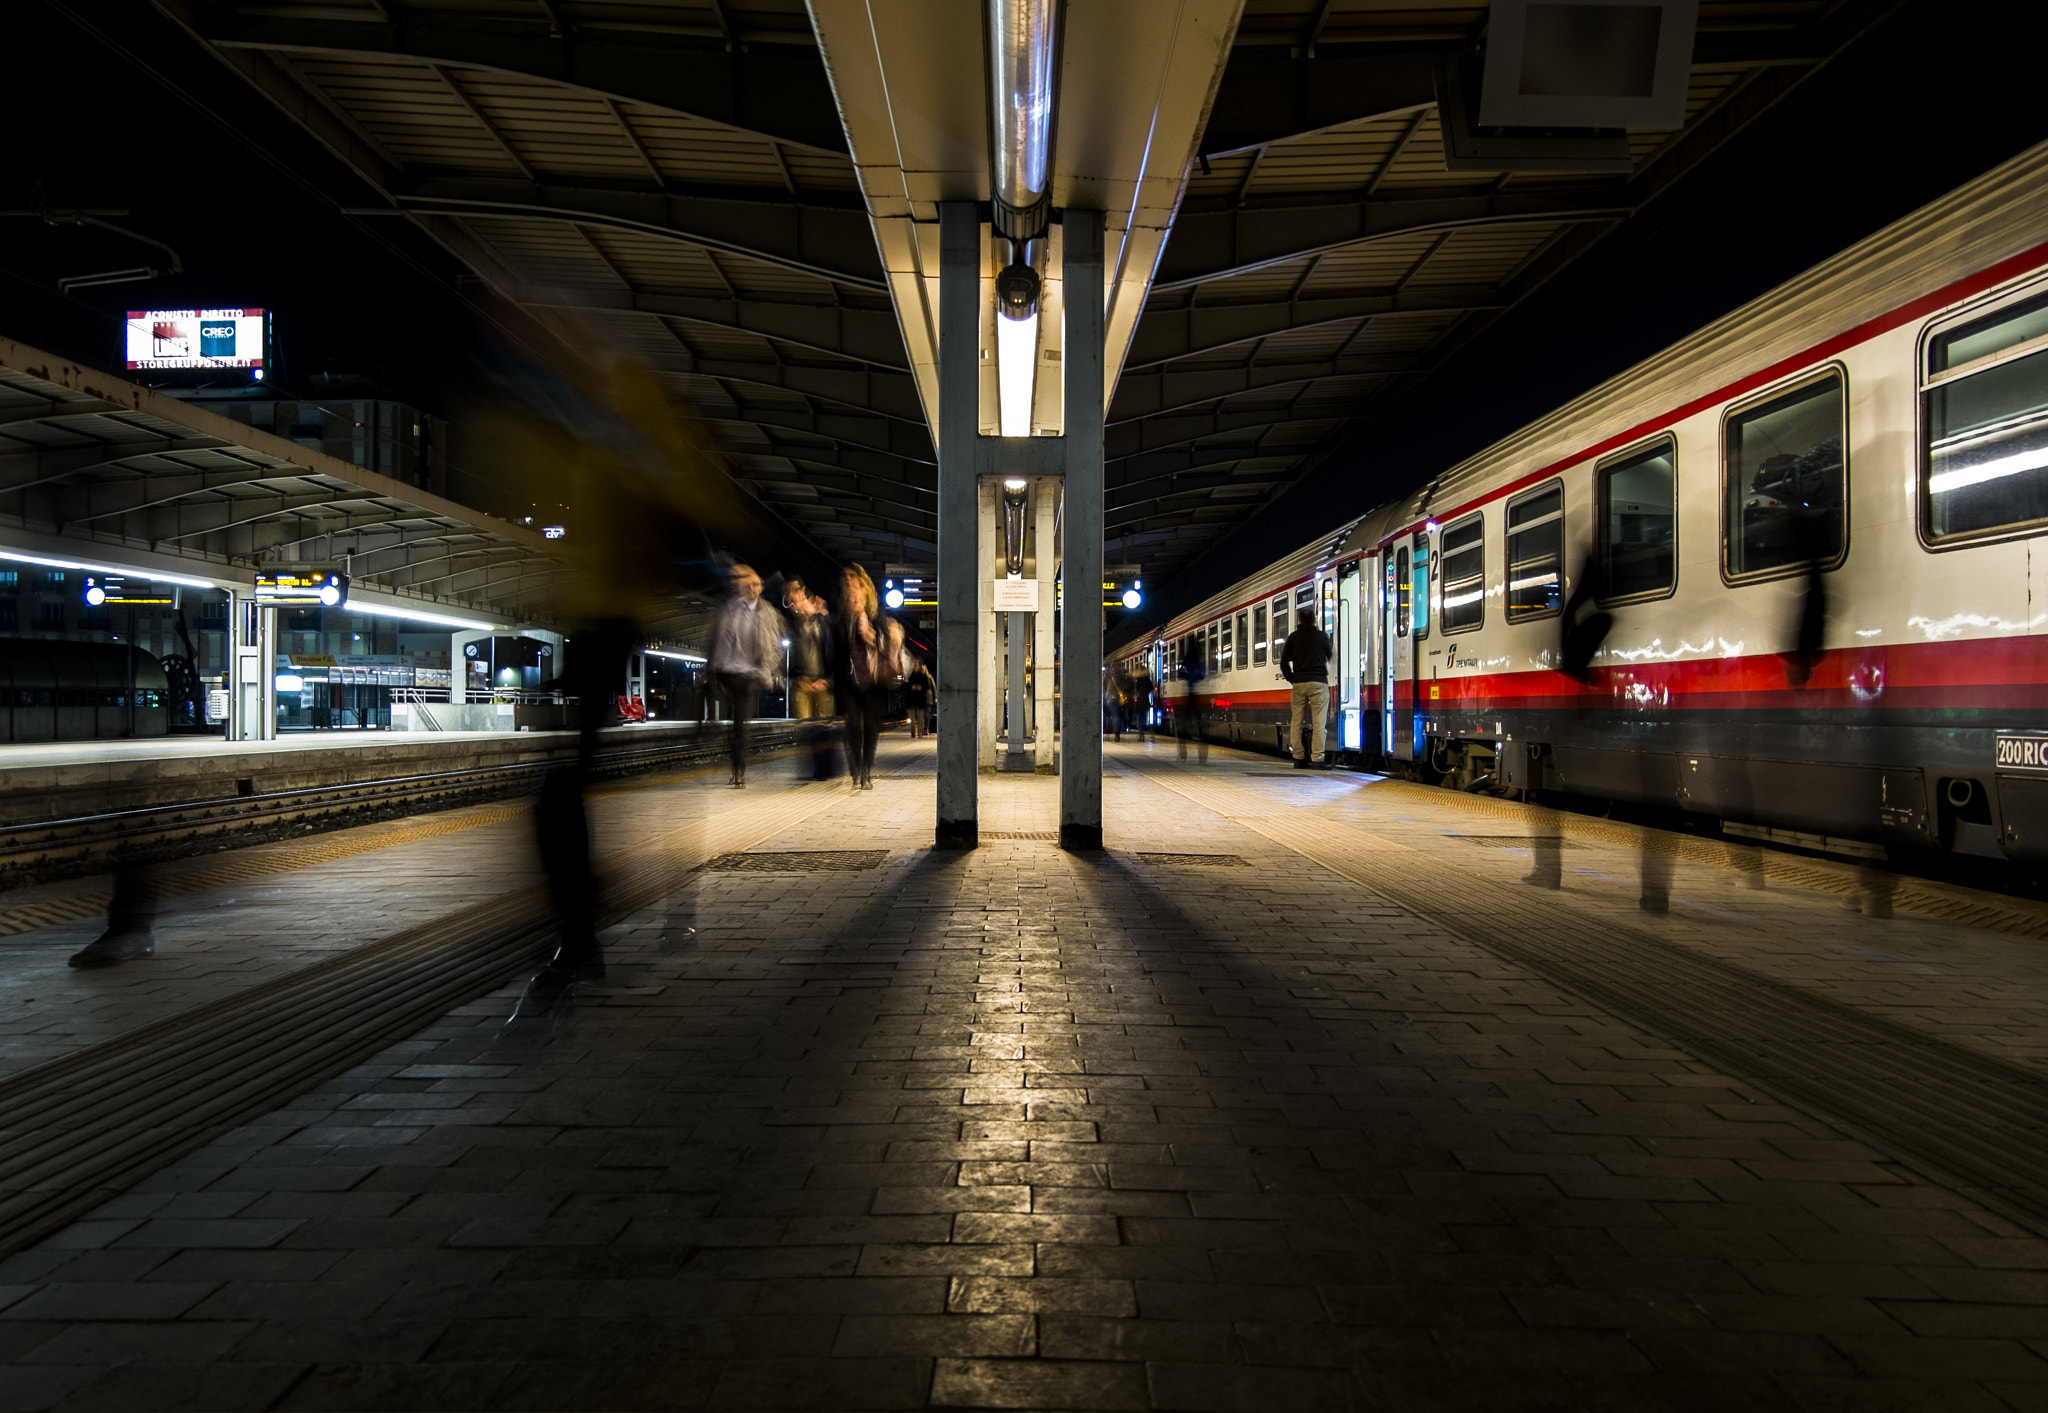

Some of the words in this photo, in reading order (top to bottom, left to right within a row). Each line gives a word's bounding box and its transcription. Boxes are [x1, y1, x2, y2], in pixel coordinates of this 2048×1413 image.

[201, 309, 244, 318] DIRETTO
[202, 326, 234, 336] CREO
[1431, 550, 1439, 582] 2
[1998, 740, 2022, 764] 200
[2024, 742, 2048, 765] RIC
